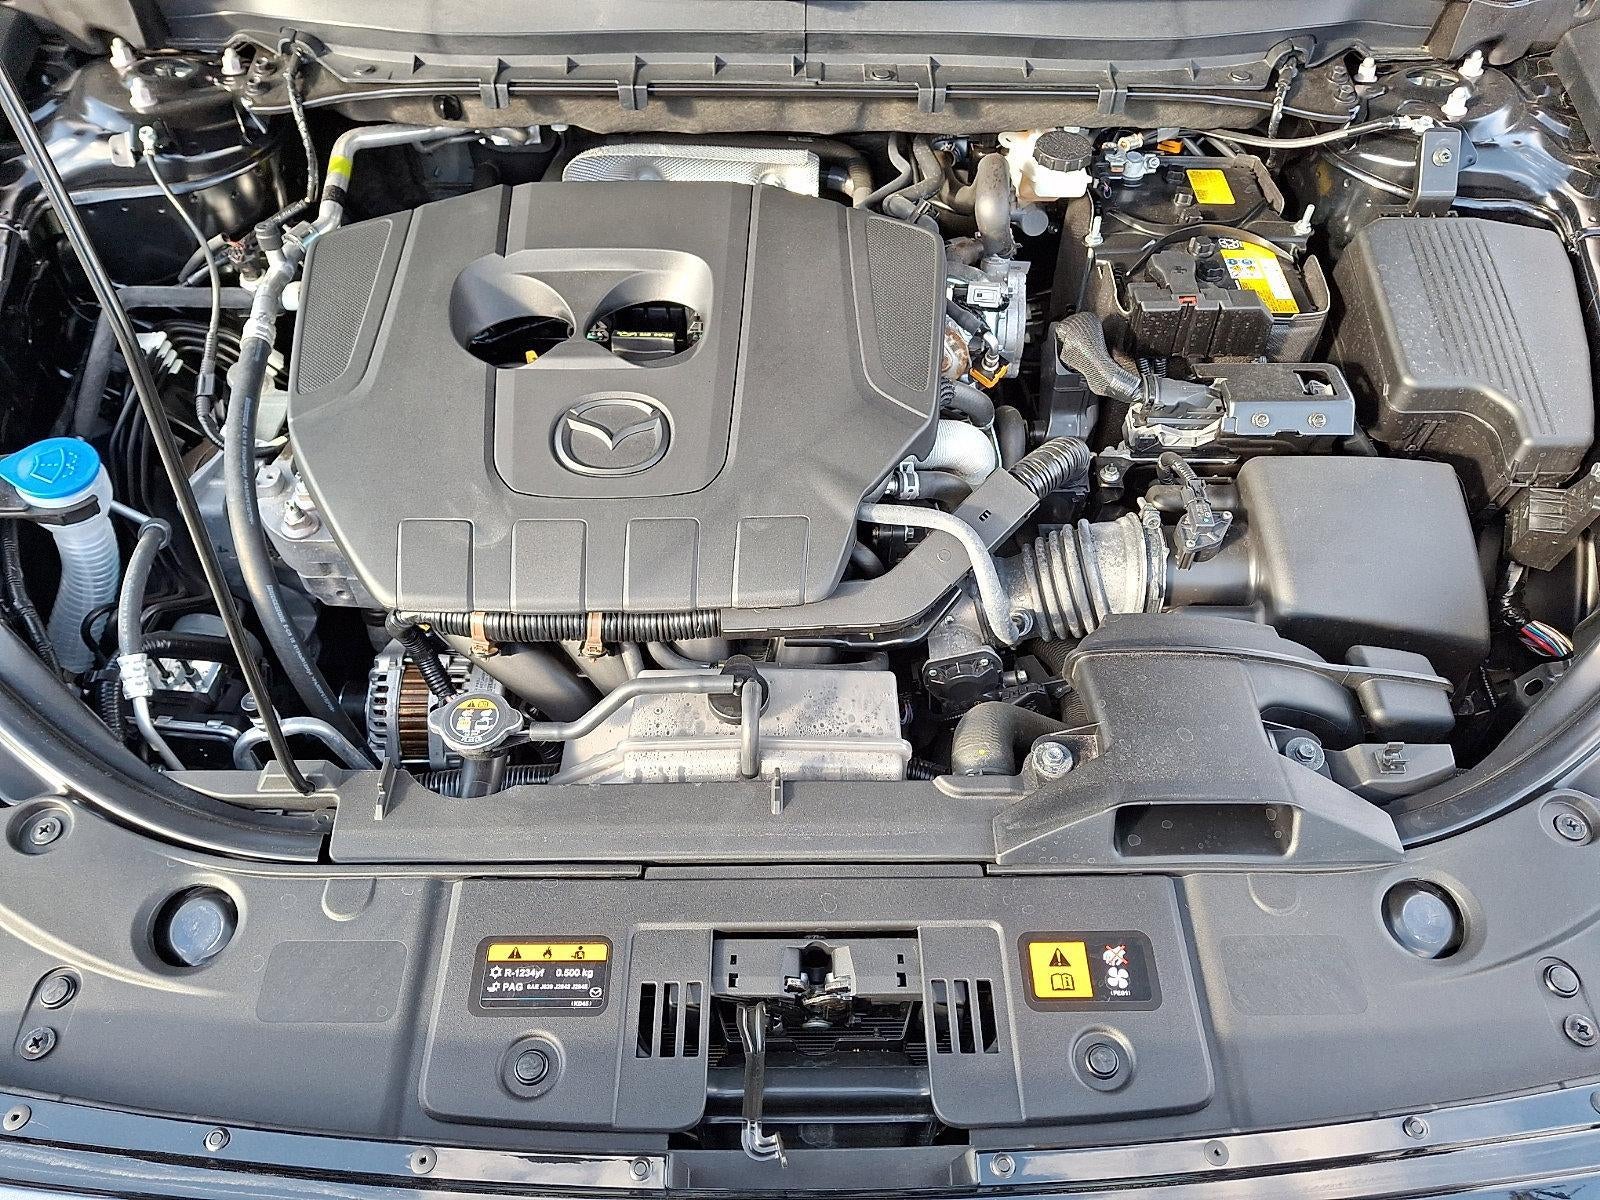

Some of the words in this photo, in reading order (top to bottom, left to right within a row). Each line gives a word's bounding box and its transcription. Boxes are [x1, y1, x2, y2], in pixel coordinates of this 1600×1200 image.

[504, 968, 545, 979] R-1234yf
[555, 968, 581, 978] 0.500
[581, 968, 594, 979] kg
[502, 982, 524, 992] PAG
